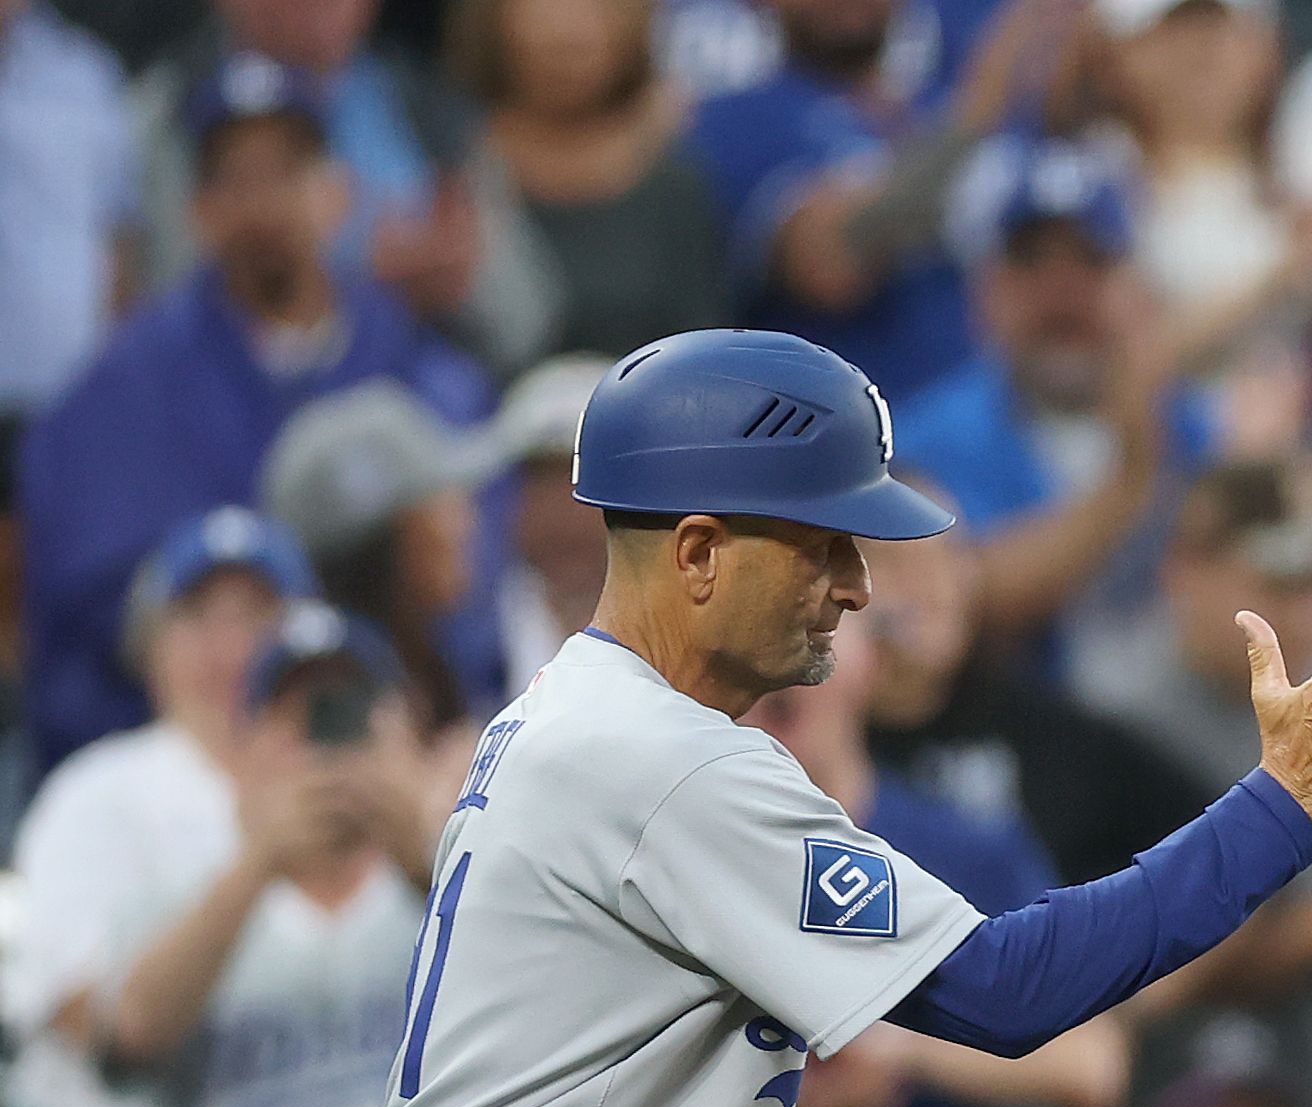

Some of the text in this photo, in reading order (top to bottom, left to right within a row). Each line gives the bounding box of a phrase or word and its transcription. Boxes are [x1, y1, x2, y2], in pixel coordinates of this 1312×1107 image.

[818, 854, 870, 907] G
[835, 879, 890, 927] GUGGENHEIM
[399, 850, 472, 1100] 1
